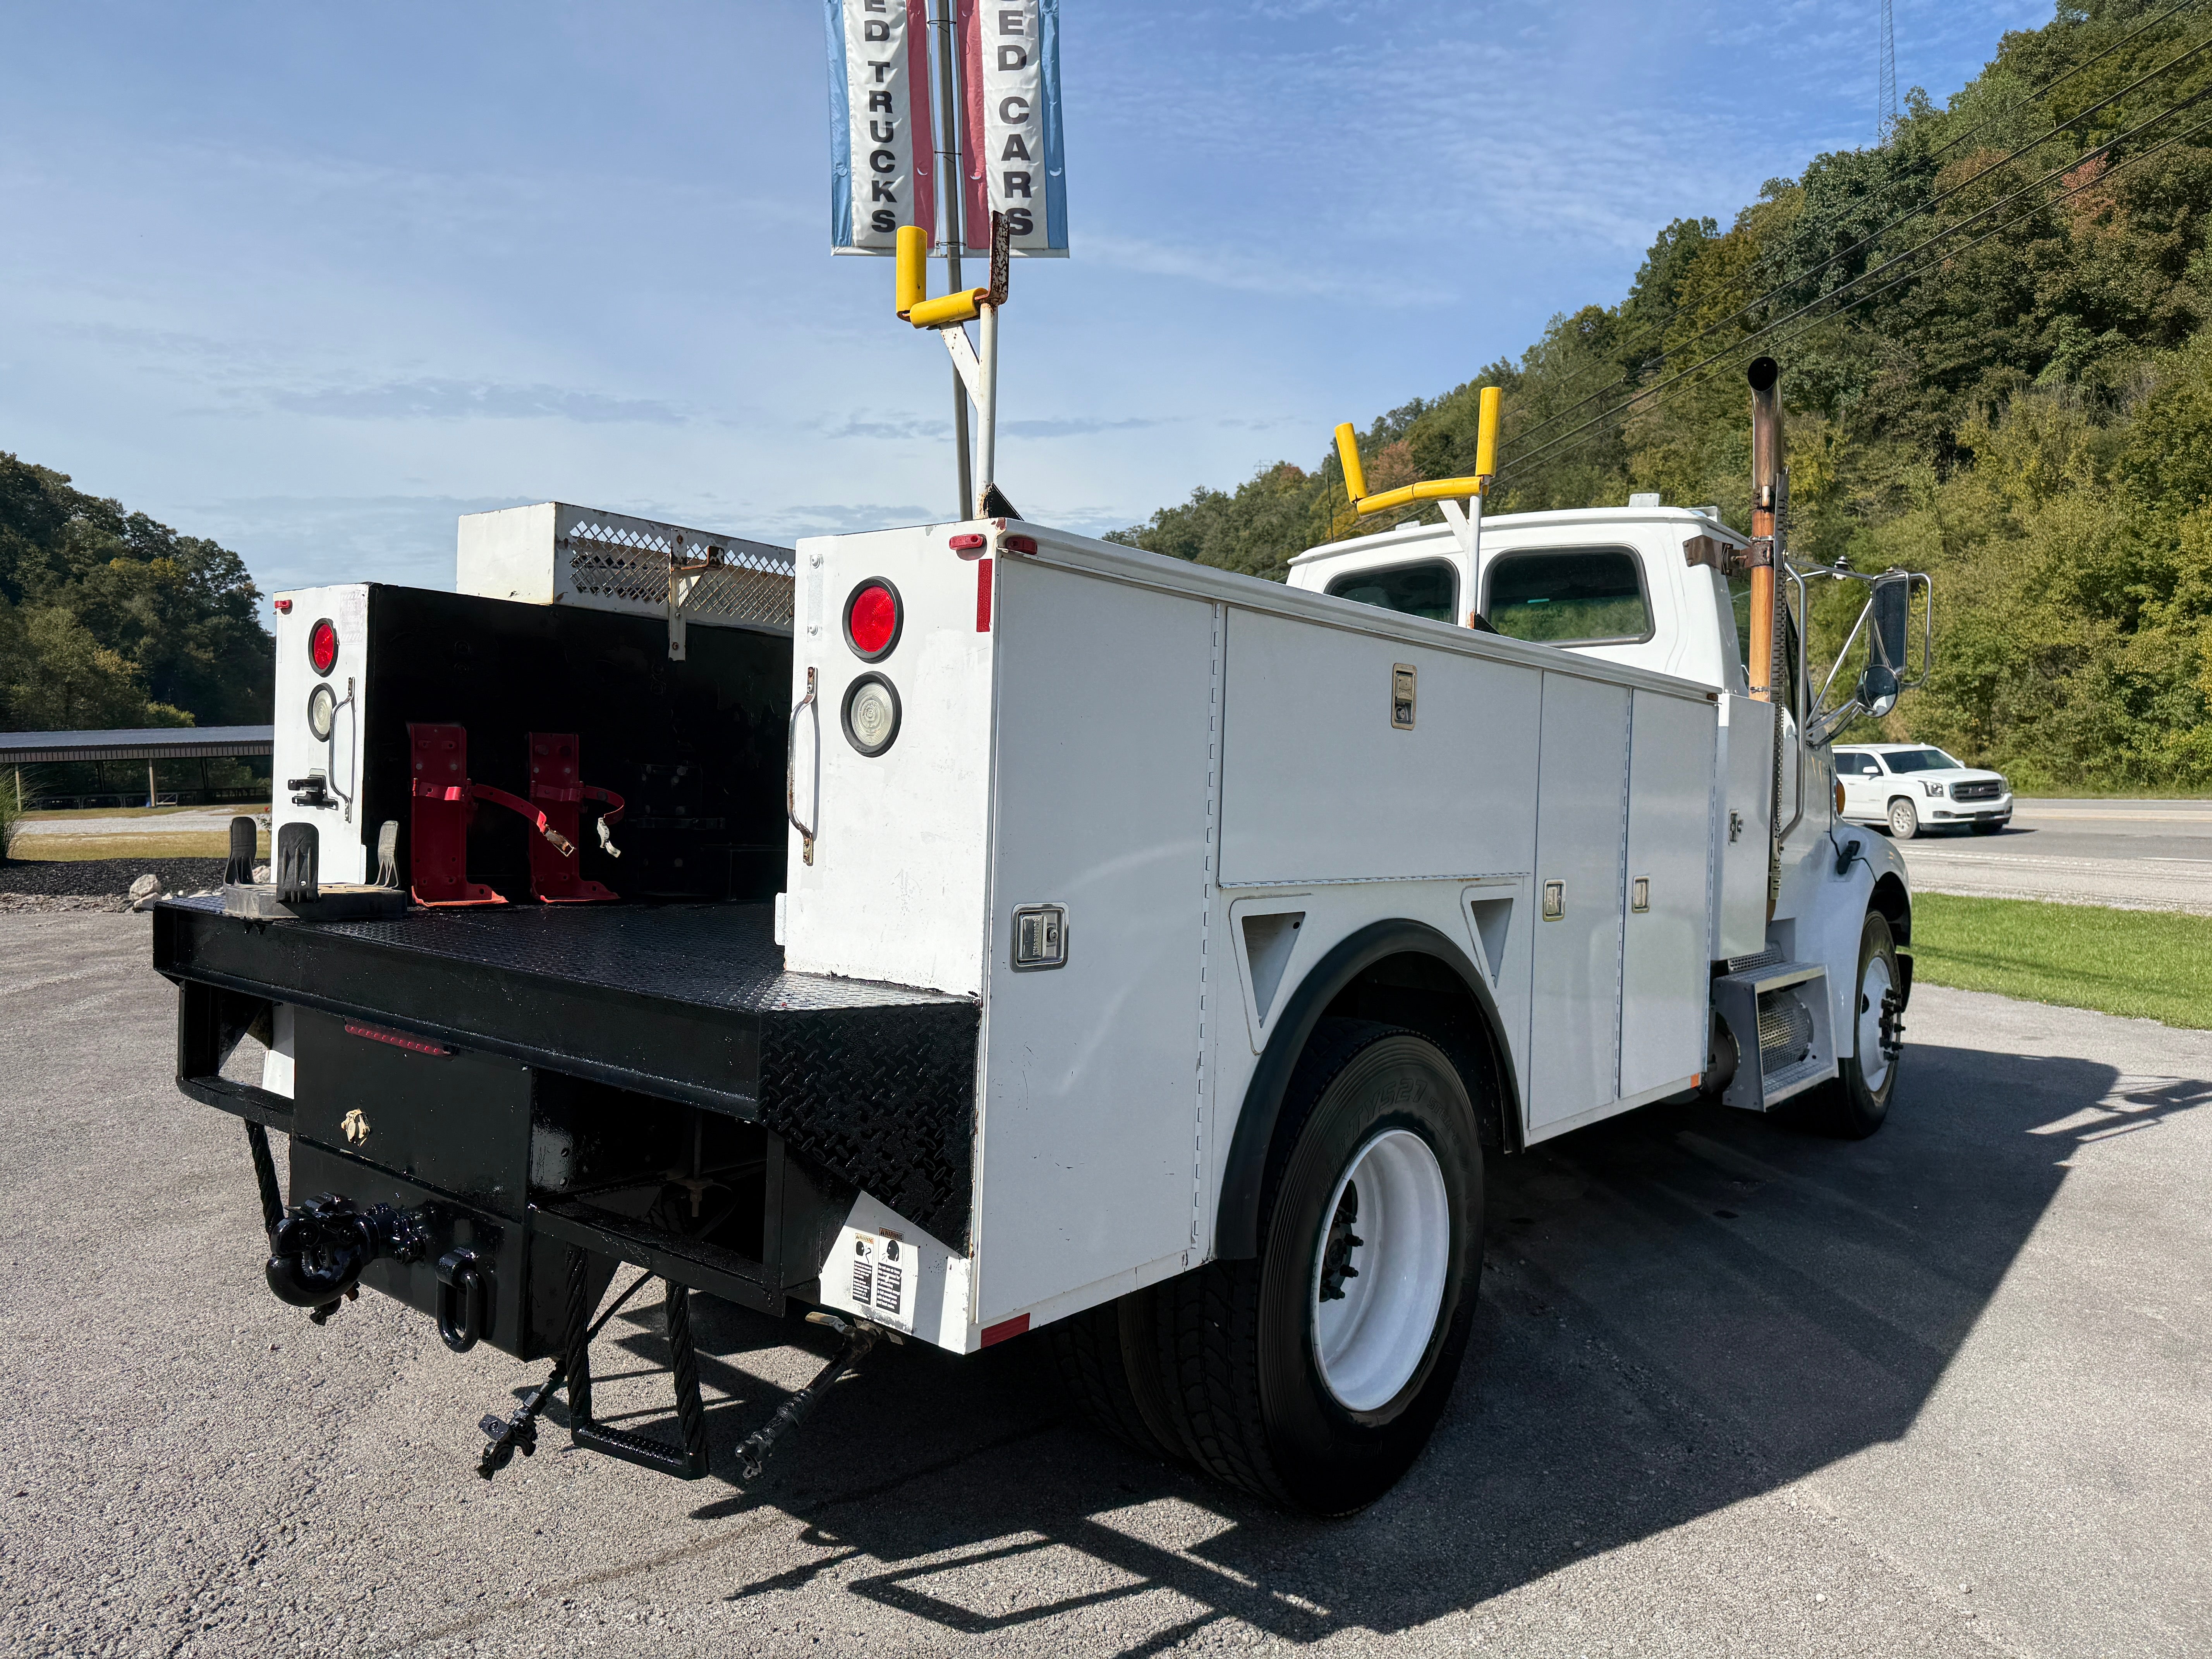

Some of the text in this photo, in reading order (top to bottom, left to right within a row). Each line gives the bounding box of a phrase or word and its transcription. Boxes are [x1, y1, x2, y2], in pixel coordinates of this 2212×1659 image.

[867, 60, 897, 233] TRUCKS
[998, 0, 1034, 236] ED CARS
